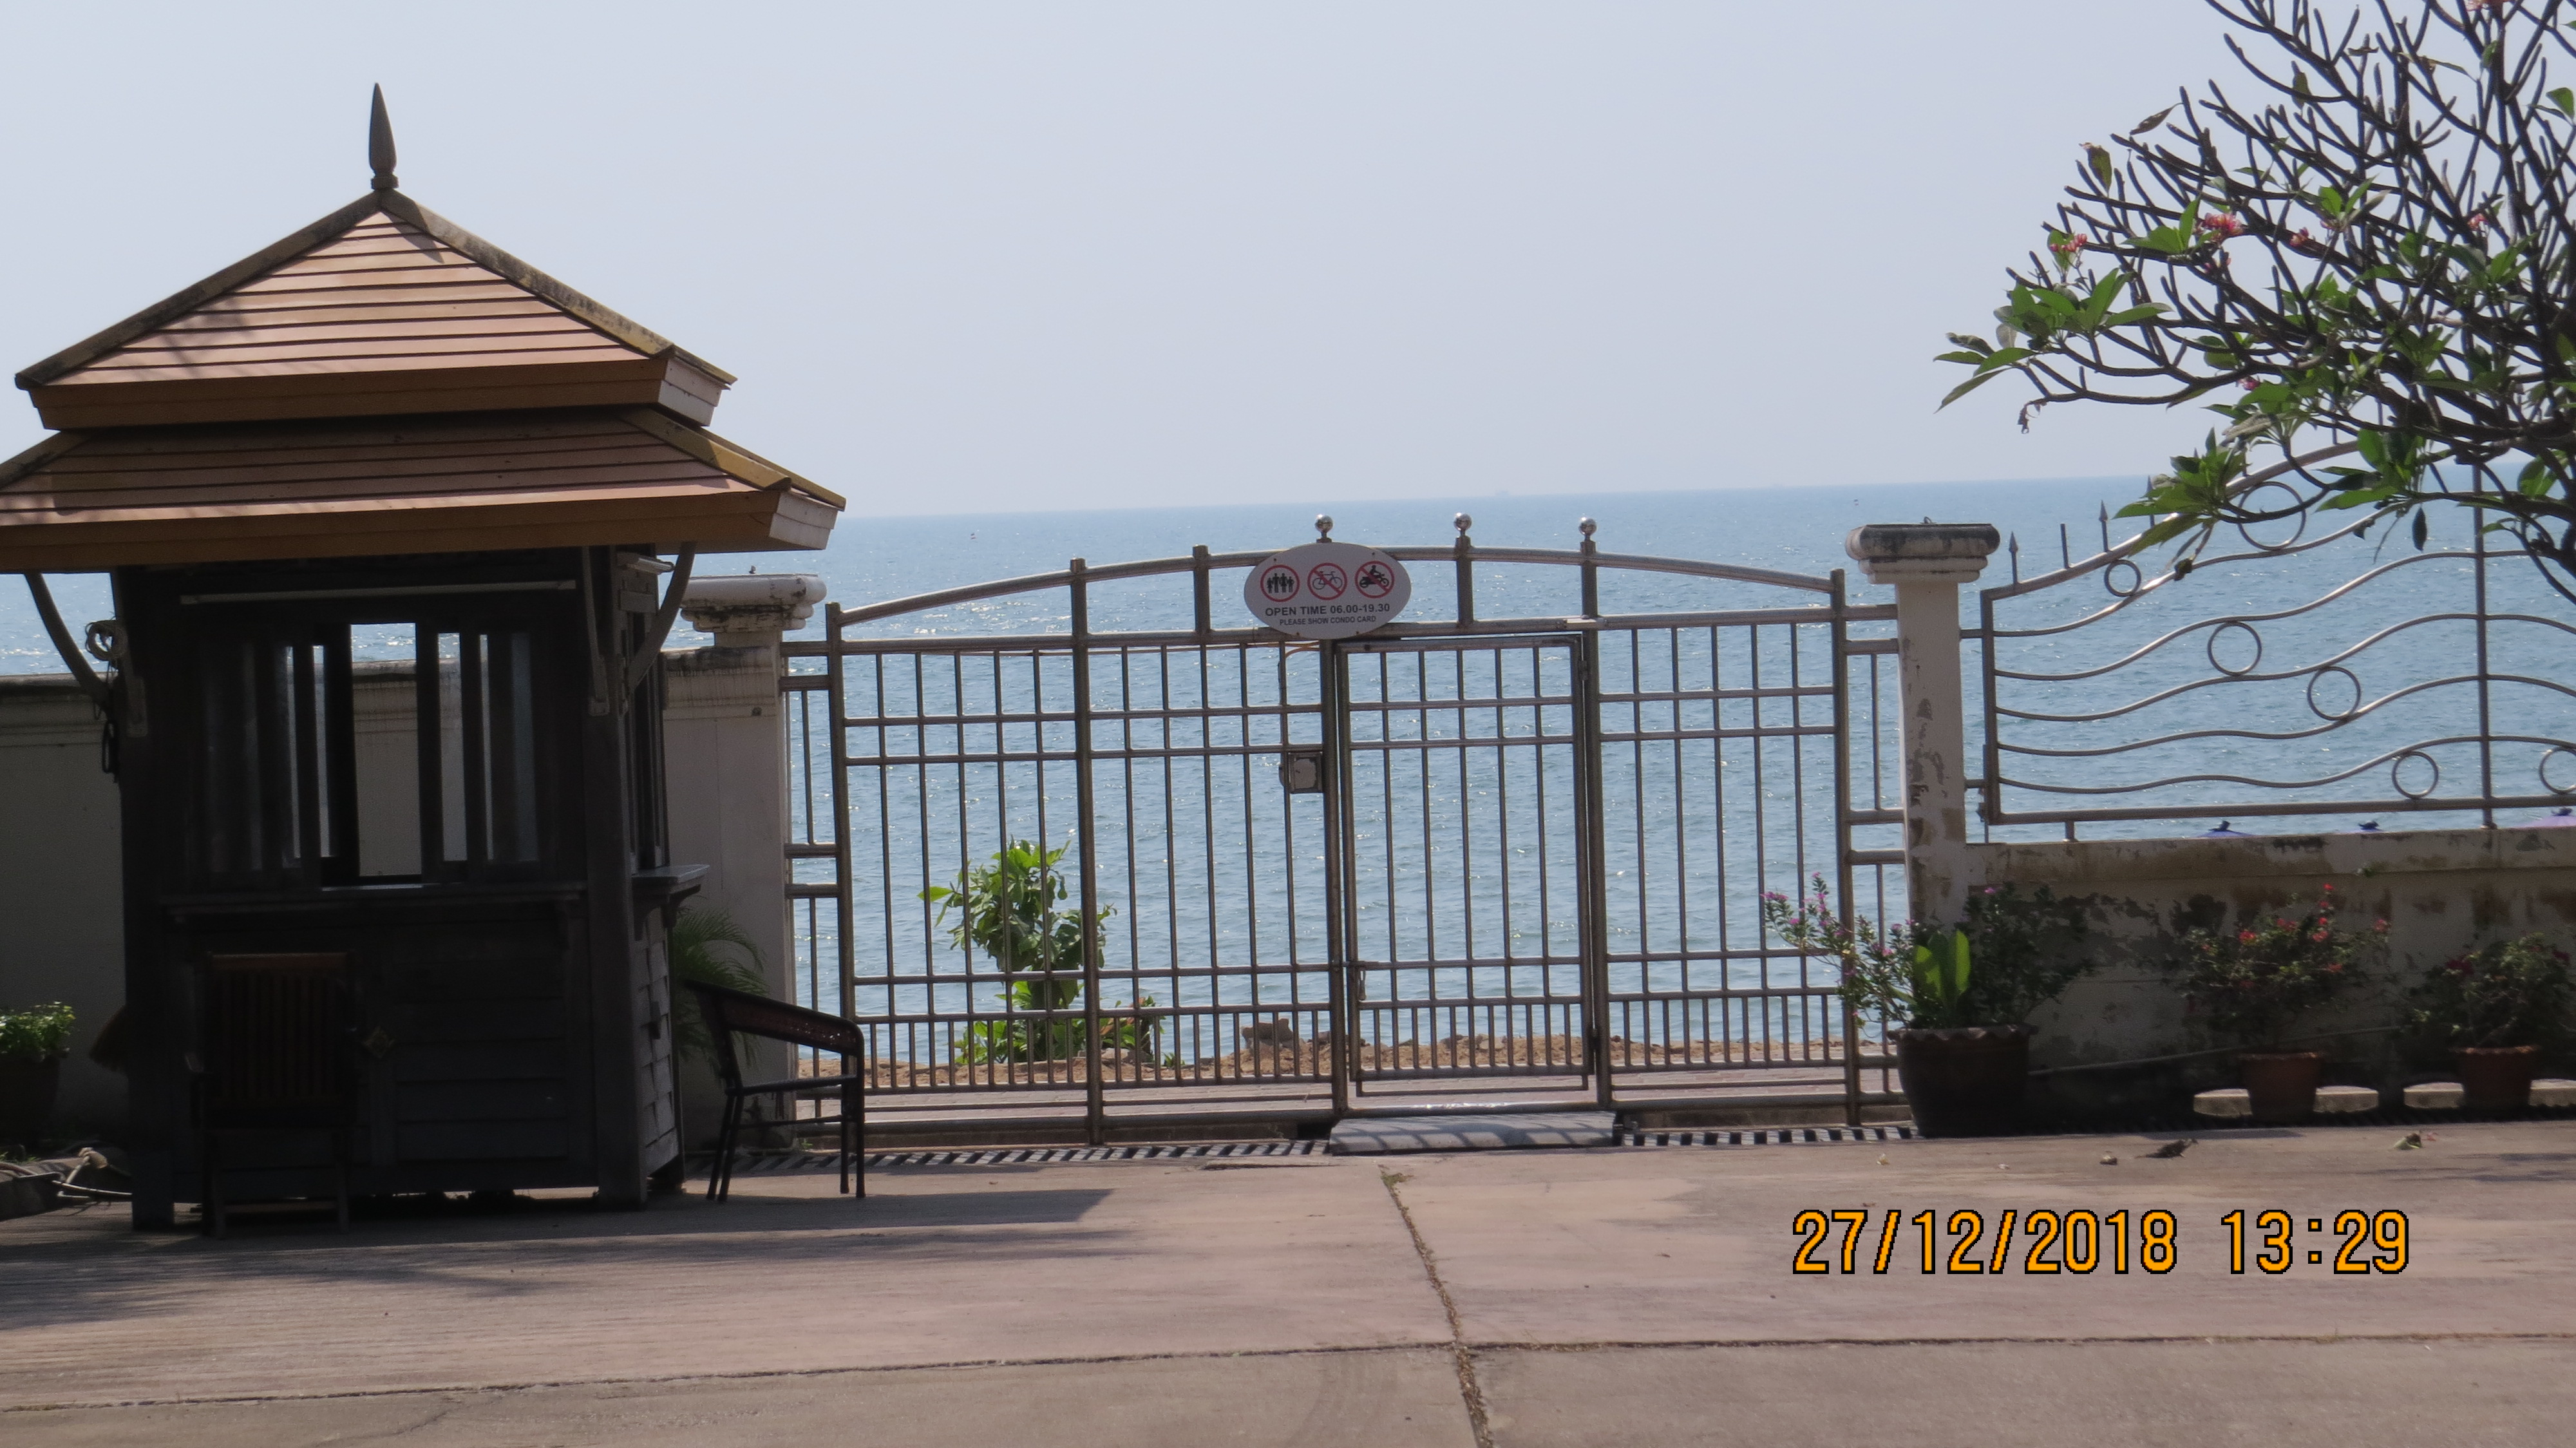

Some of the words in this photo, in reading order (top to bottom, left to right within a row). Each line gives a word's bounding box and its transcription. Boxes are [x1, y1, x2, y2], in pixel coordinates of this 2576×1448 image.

[1265, 607, 1296, 616] OPEN
[1300, 605, 1327, 614] TIME
[1330, 603, 1390, 613] 06.00-19.30
